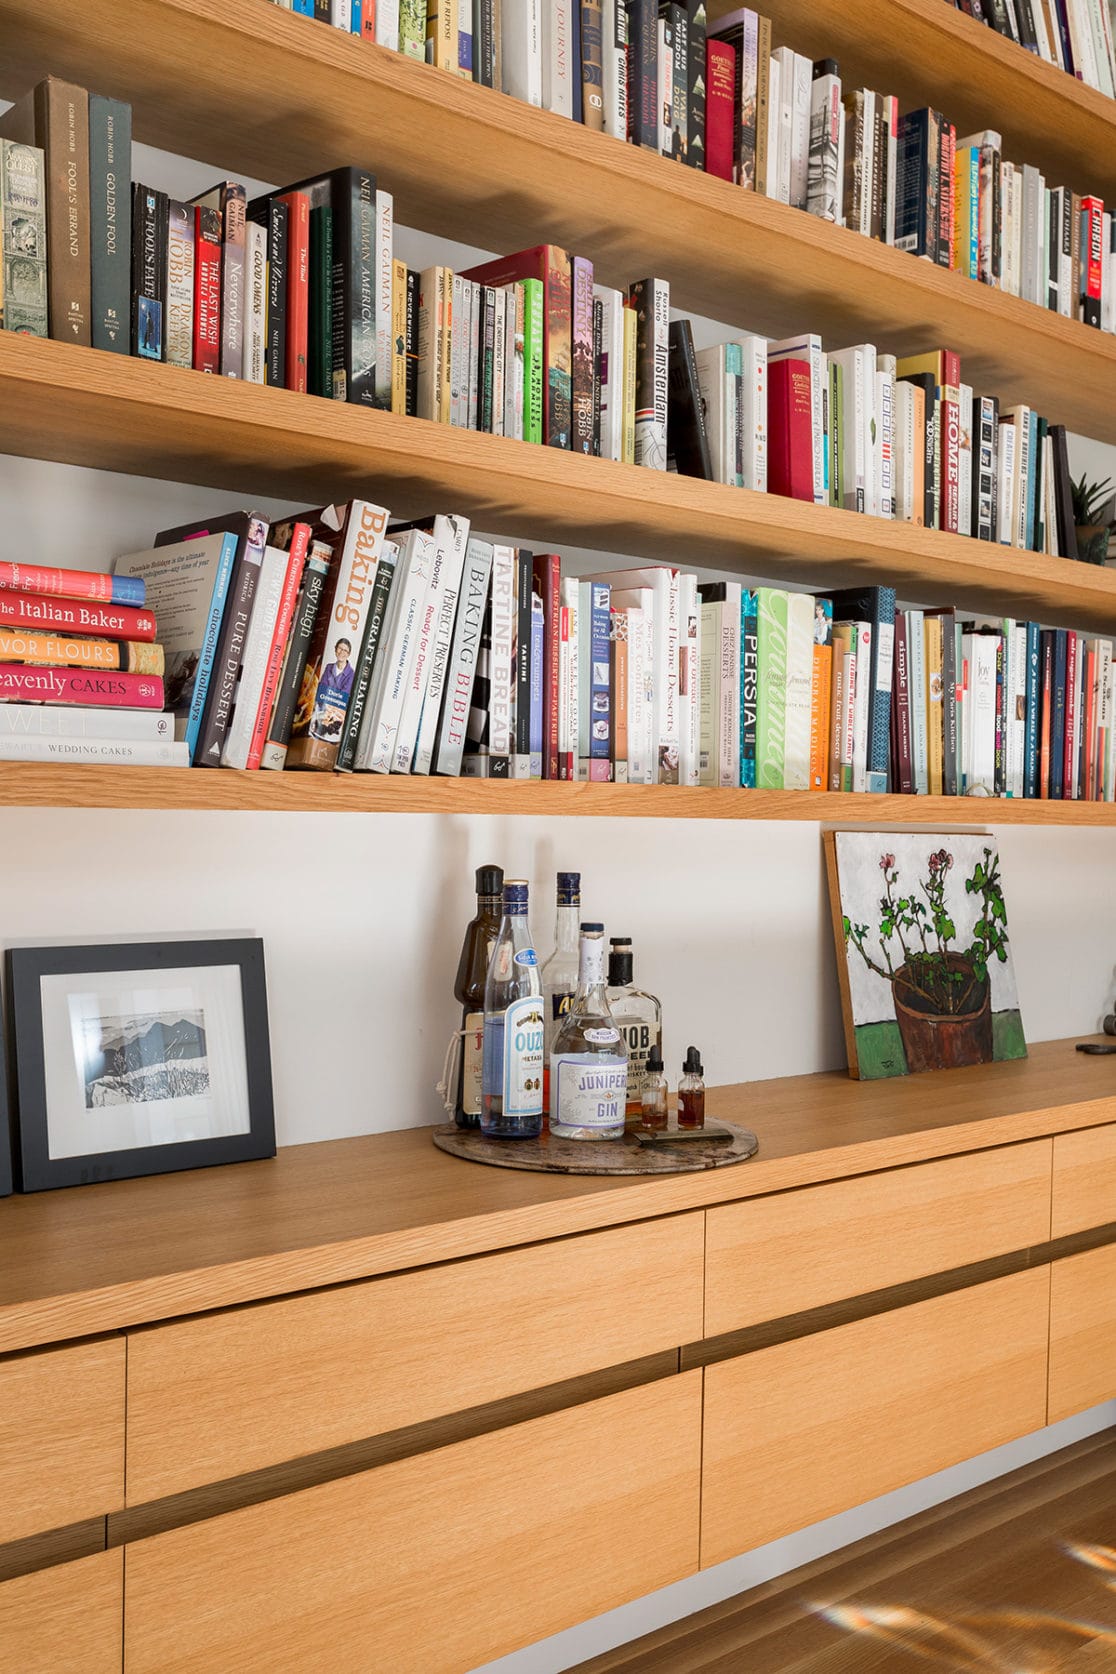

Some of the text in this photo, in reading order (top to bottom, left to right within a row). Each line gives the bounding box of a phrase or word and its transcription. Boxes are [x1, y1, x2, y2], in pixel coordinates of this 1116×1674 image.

[557, 7, 565, 80] JOURNEY
[68, 161, 79, 257] FOOL'S ERRAND
[106, 172, 116, 256] GOLDEN FOOL
[228, 202, 236, 240] GAIMAN
[272, 208, 284, 242] Smoke
[1092, 207, 1101, 260] CHABON
[145, 220, 155, 297] FOOL'S FATE
[170, 228, 183, 284] HOBB
[184, 241, 193, 277] ROBIN
[254, 250, 262, 315] GOOD OMENS
[360, 176, 372, 376] NEIL GAIMAN AMERICAN GODS
[382, 205, 390, 313] NEIL GAIMAN
[169, 304, 180, 352] KEEPER
[180, 303, 190, 358] DRAGON
[209, 261, 218, 344] THE LAST WISH
[228, 262, 242, 350] Neverwhere
[576, 267, 586, 338] DESTINY
[656, 344, 668, 423] Amsterdam
[578, 398, 587, 437] HOBB
[948, 400, 959, 482] HOME
[10, 562, 20, 589] French
[22, 575, 34, 590] Fry
[240, 572, 251, 602] MEDRICH
[278, 558, 300, 635] CHRISTMAS COOKIES
[335, 506, 387, 631] Baking
[431, 549, 445, 590] Lebovitz
[0, 600, 125, 629] he Italian Baker
[299, 577, 323, 638] sky high
[375, 596, 384, 615] THE
[47, 641, 113, 662] FLOURS
[192, 608, 222, 721] chocolate holidays
[365, 616, 381, 663] CRAFT
[392, 598, 417, 699] CLASSIC GERMAN BAKING
[412, 605, 435, 690] Ready for Dessert
[430, 589, 457, 698] PERFECT PRESERVES
[448, 569, 485, 744] BAKING BIBLE
[493, 550, 512, 752] TARTINE BREAD
[667, 580, 678, 732] Classic Home Desserts
[898, 640, 906, 688] simple
[0, 671, 126, 696] avenly CAKES
[215, 611, 247, 732] PURE DESSERT
[744, 635, 757, 726] PERSIA
[949, 682, 955, 692] My
[351, 680, 368, 738] BAKING
[811, 657, 820, 773] DEBORAH MADISON
[48, 744, 133, 756] WEDDING CAKES
[579, 1075, 626, 1090] JUNIPER
[597, 1102, 618, 1117] GIN
